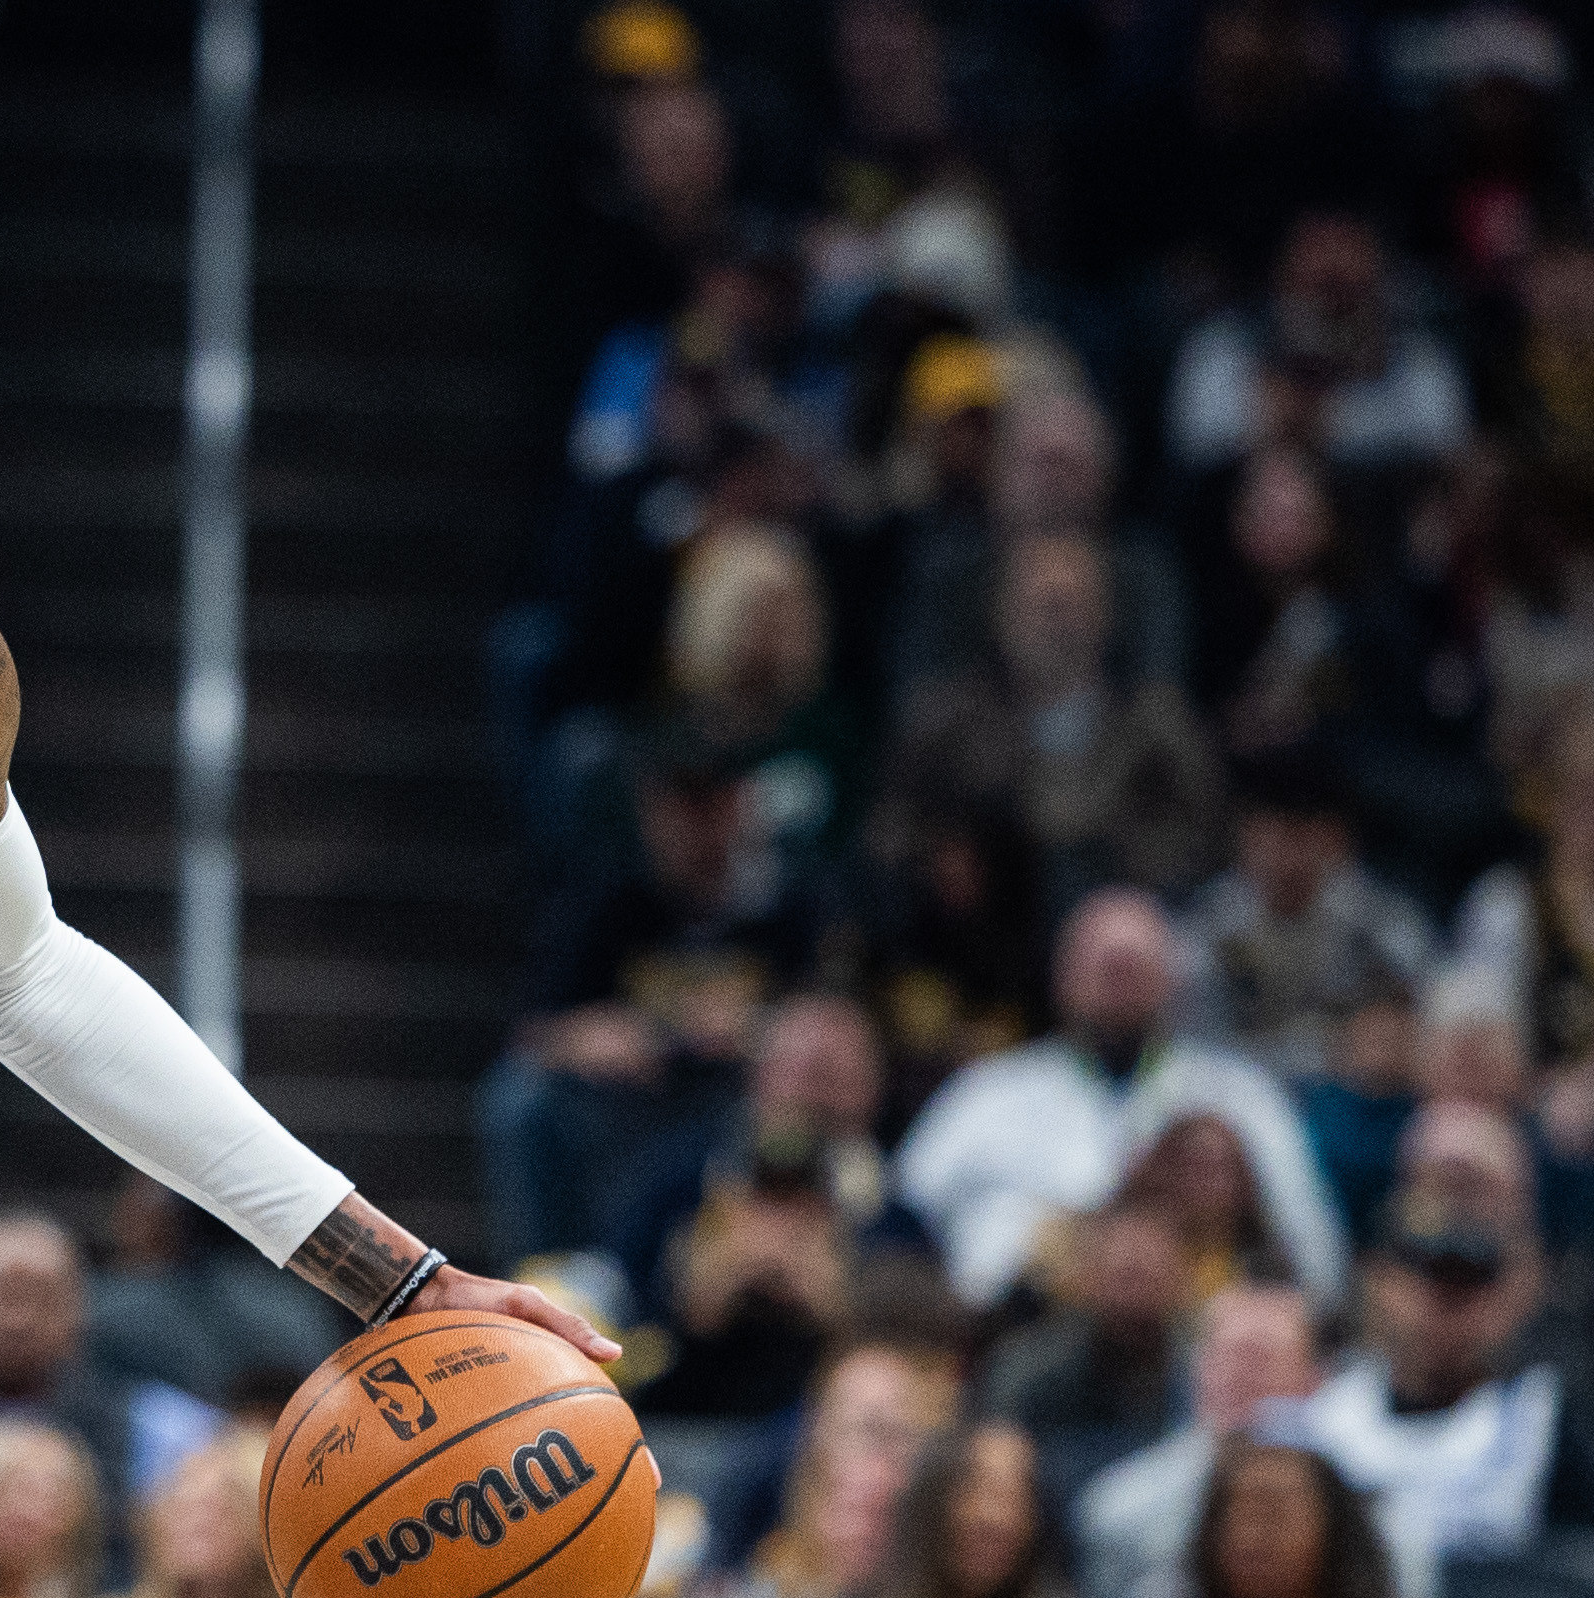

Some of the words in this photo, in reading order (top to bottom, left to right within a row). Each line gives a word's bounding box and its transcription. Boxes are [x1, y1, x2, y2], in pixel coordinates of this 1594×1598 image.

[425, 1367, 449, 1385] BALL
[447, 1359, 473, 1377] GAME
[342, 1428, 598, 1588] Wilson
